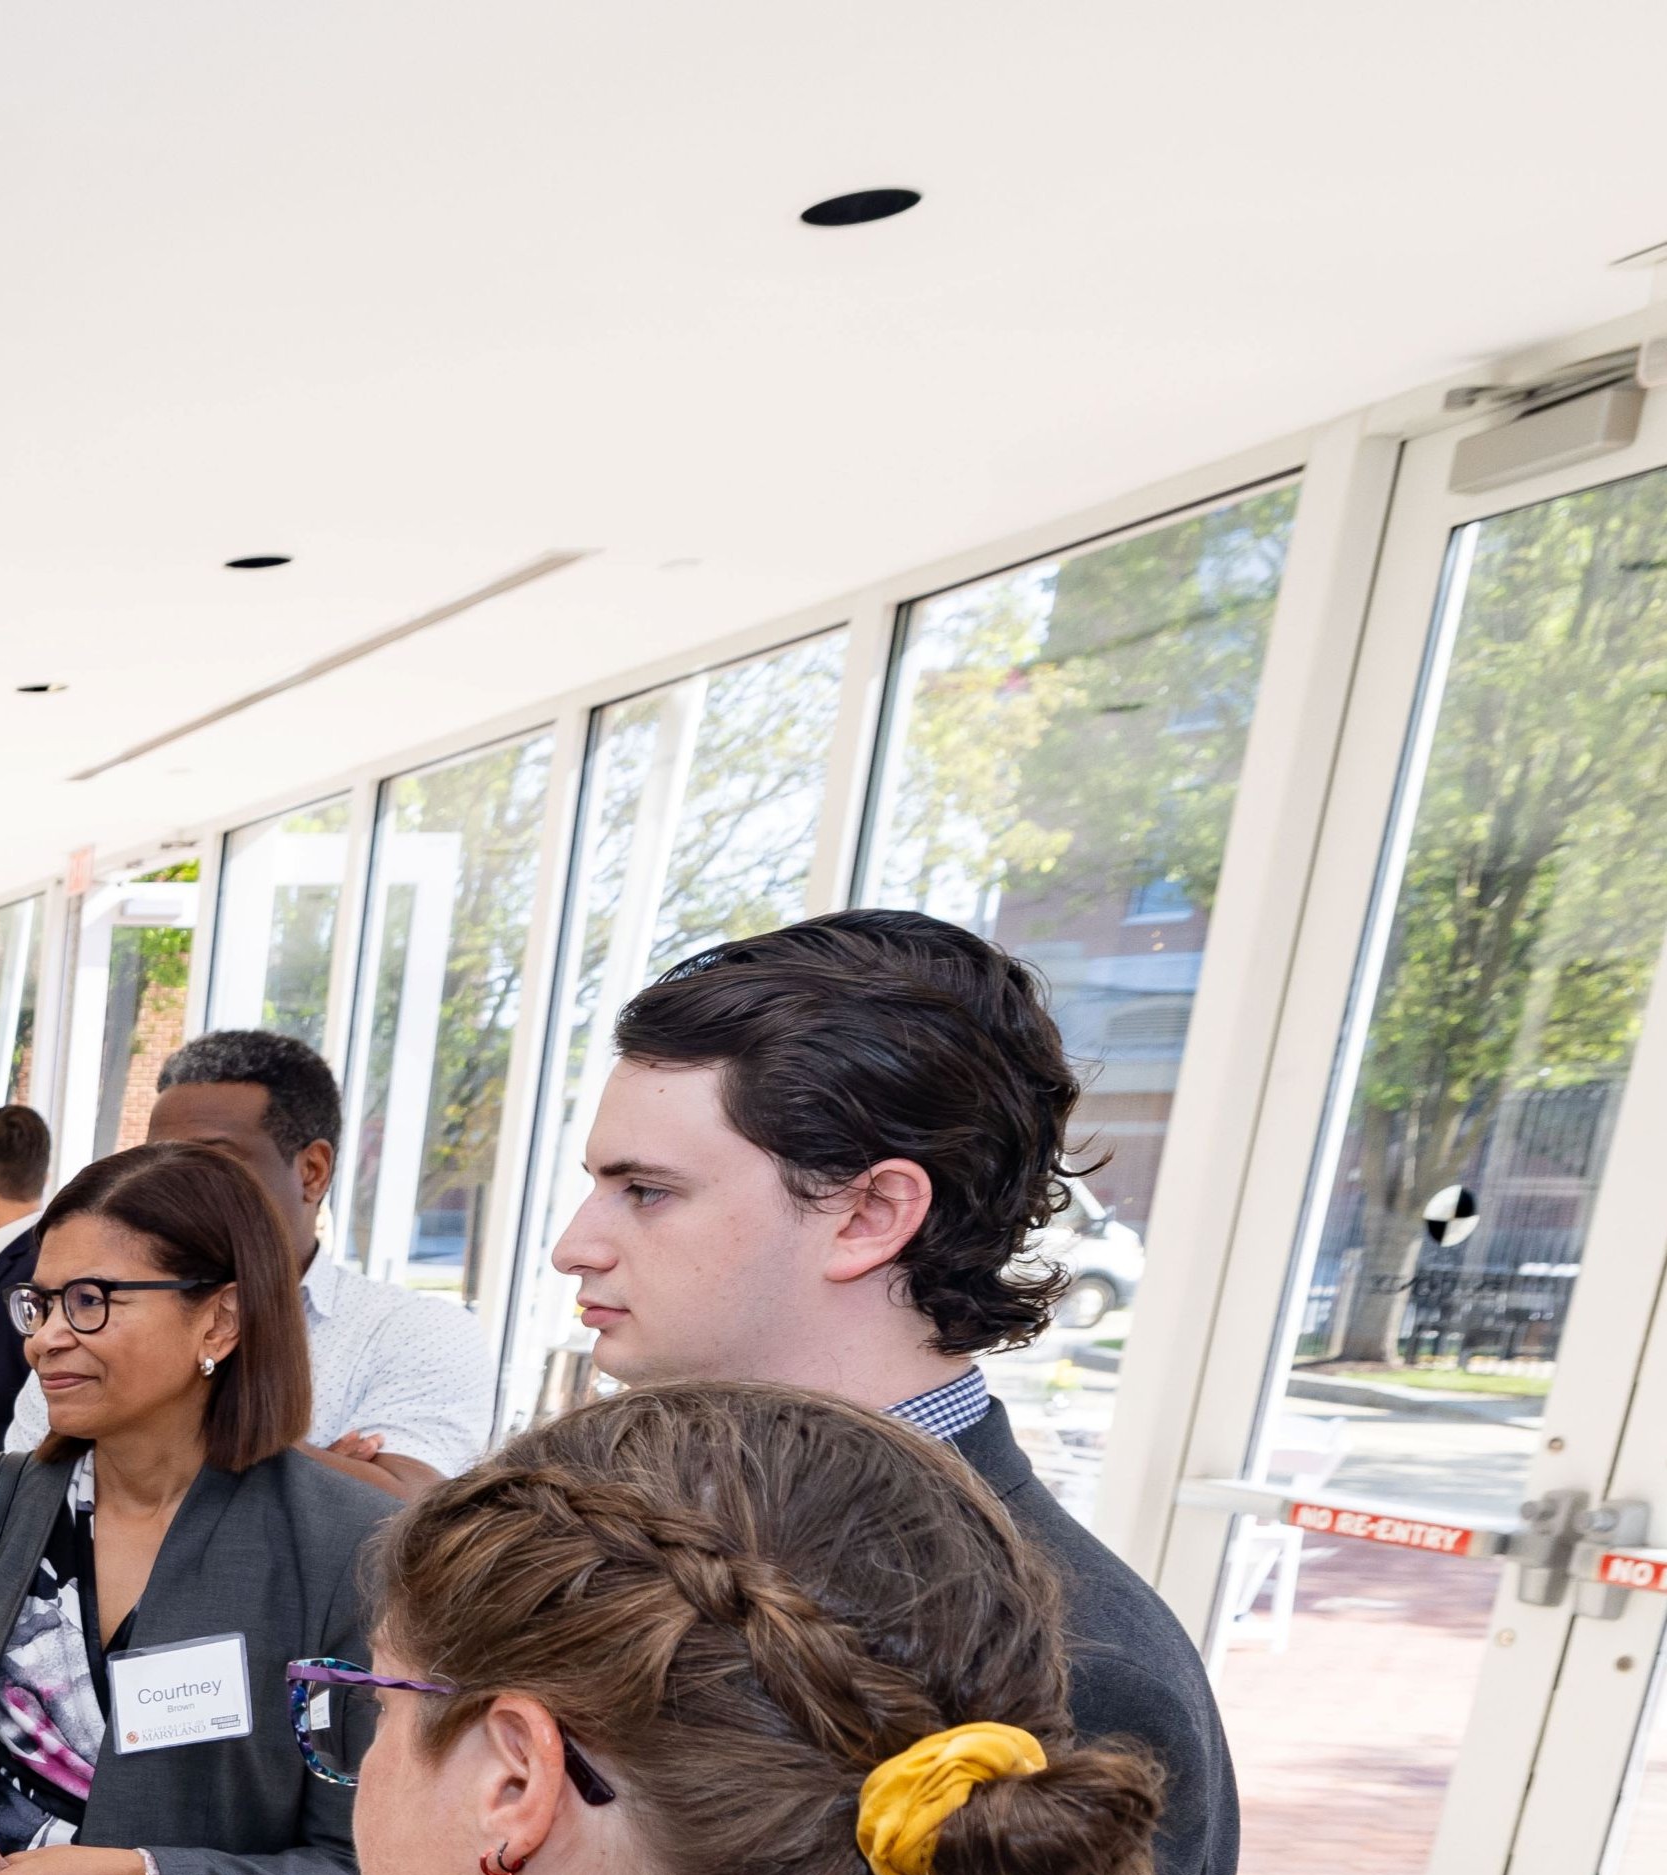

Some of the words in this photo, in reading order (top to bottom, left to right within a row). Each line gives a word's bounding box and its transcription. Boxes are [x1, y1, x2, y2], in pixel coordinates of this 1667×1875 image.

[1296, 1505, 1333, 1529] NO
[1333, 1512, 1464, 1550] RE-ENTRY
[1608, 1558, 1654, 1586] NO
[137, 1678, 222, 1704] Courtney
[167, 1702, 195, 1714] Brown
[142, 1724, 207, 1743] MARYLAND
